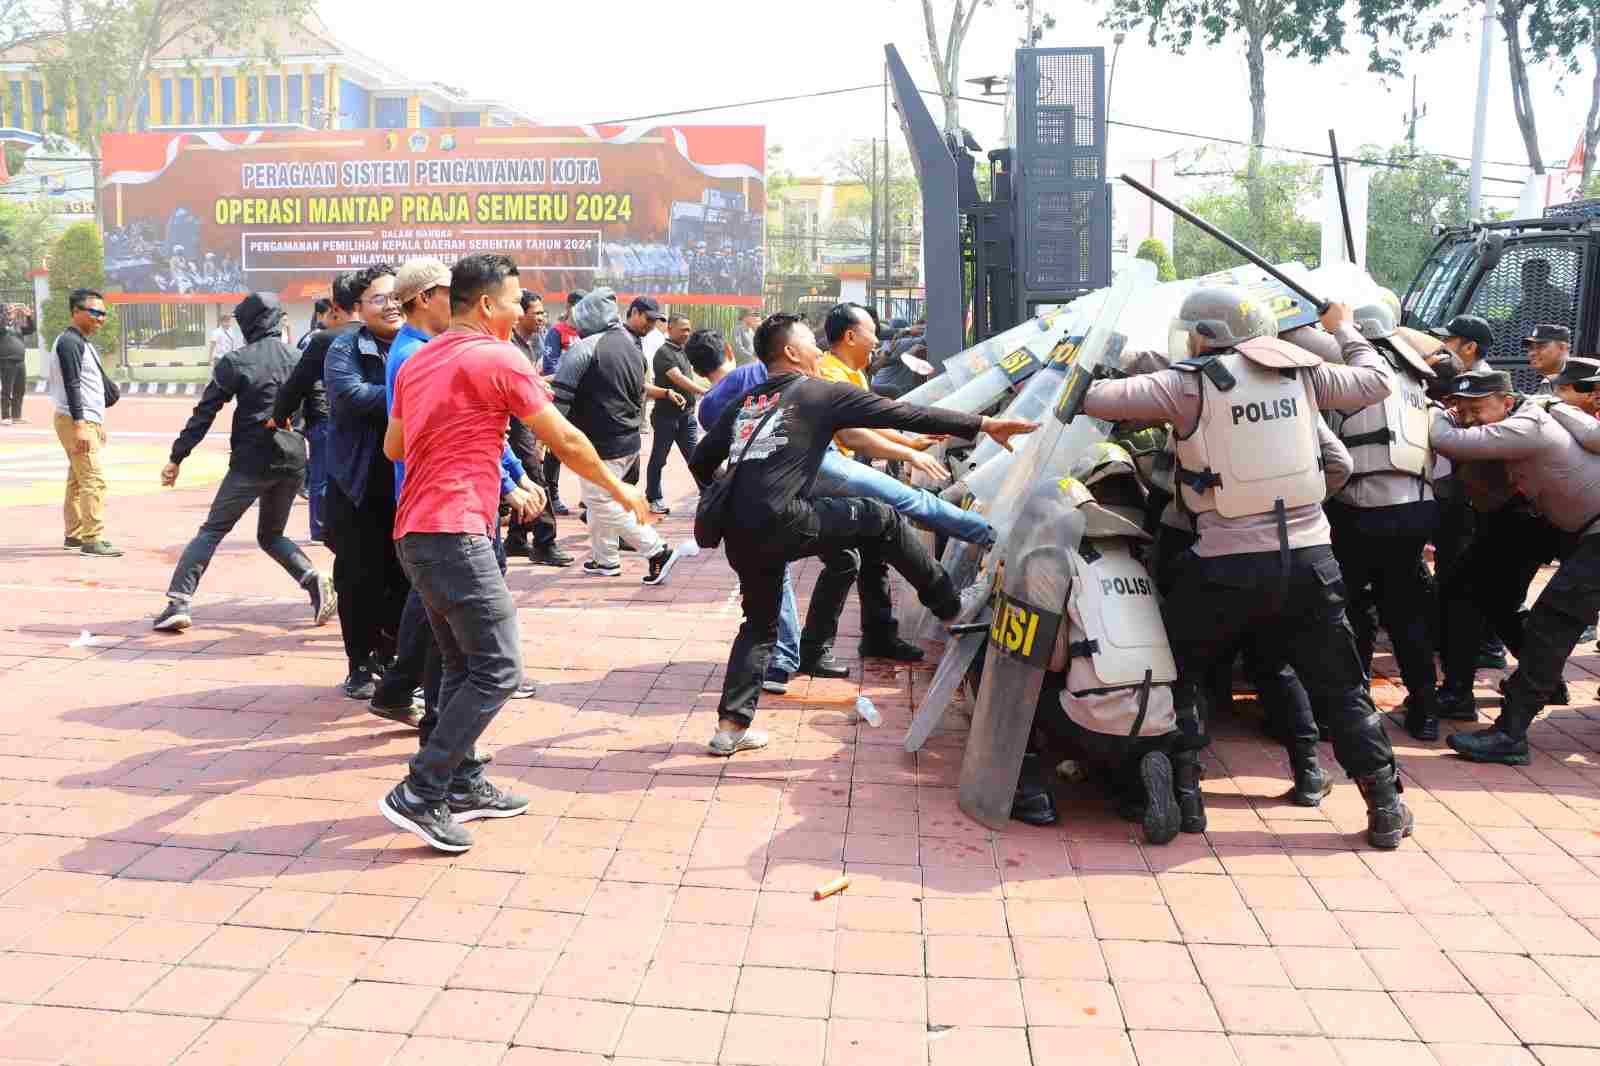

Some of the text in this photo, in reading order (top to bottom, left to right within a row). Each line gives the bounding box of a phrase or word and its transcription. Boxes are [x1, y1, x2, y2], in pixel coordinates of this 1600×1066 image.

[242, 158, 601, 189] PERAGAAN SISTEM PENGAMANAN KOTA
[215, 193, 632, 224] OPERASI MANTAP PRAJA SEMERU 2024
[322, 239, 379, 251] PEMILIHAN
[382, 239, 420, 250] KEPALA
[424, 239, 465, 250] DAERAH
[469, 239, 522, 250] SERENTAK
[526, 239, 561, 250] TAHUN
[564, 239, 592, 250] 2024
[336, 254, 347, 265] DI
[350, 253, 394, 265] WILAYAH
[1231, 398, 1298, 425] POLISI
[1101, 577, 1153, 597] POLISI
